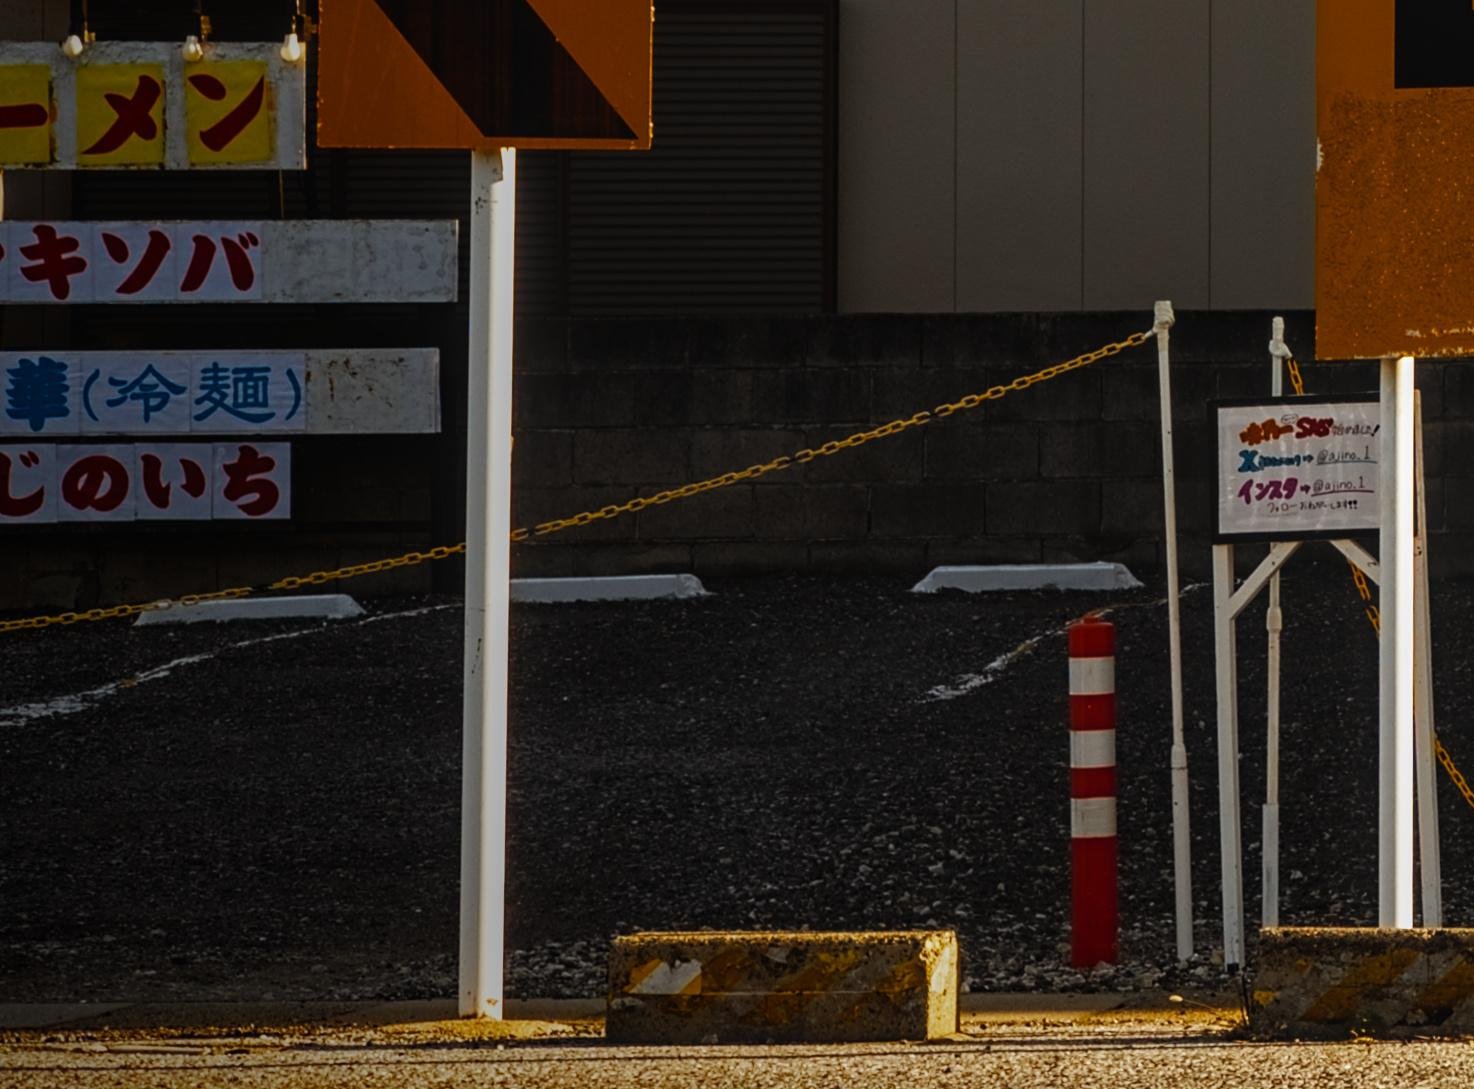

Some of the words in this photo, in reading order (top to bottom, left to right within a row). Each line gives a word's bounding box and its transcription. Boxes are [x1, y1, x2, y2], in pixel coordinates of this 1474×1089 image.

[0, 224, 258, 300] キソバ
[0, 444, 280, 517] じのいち
